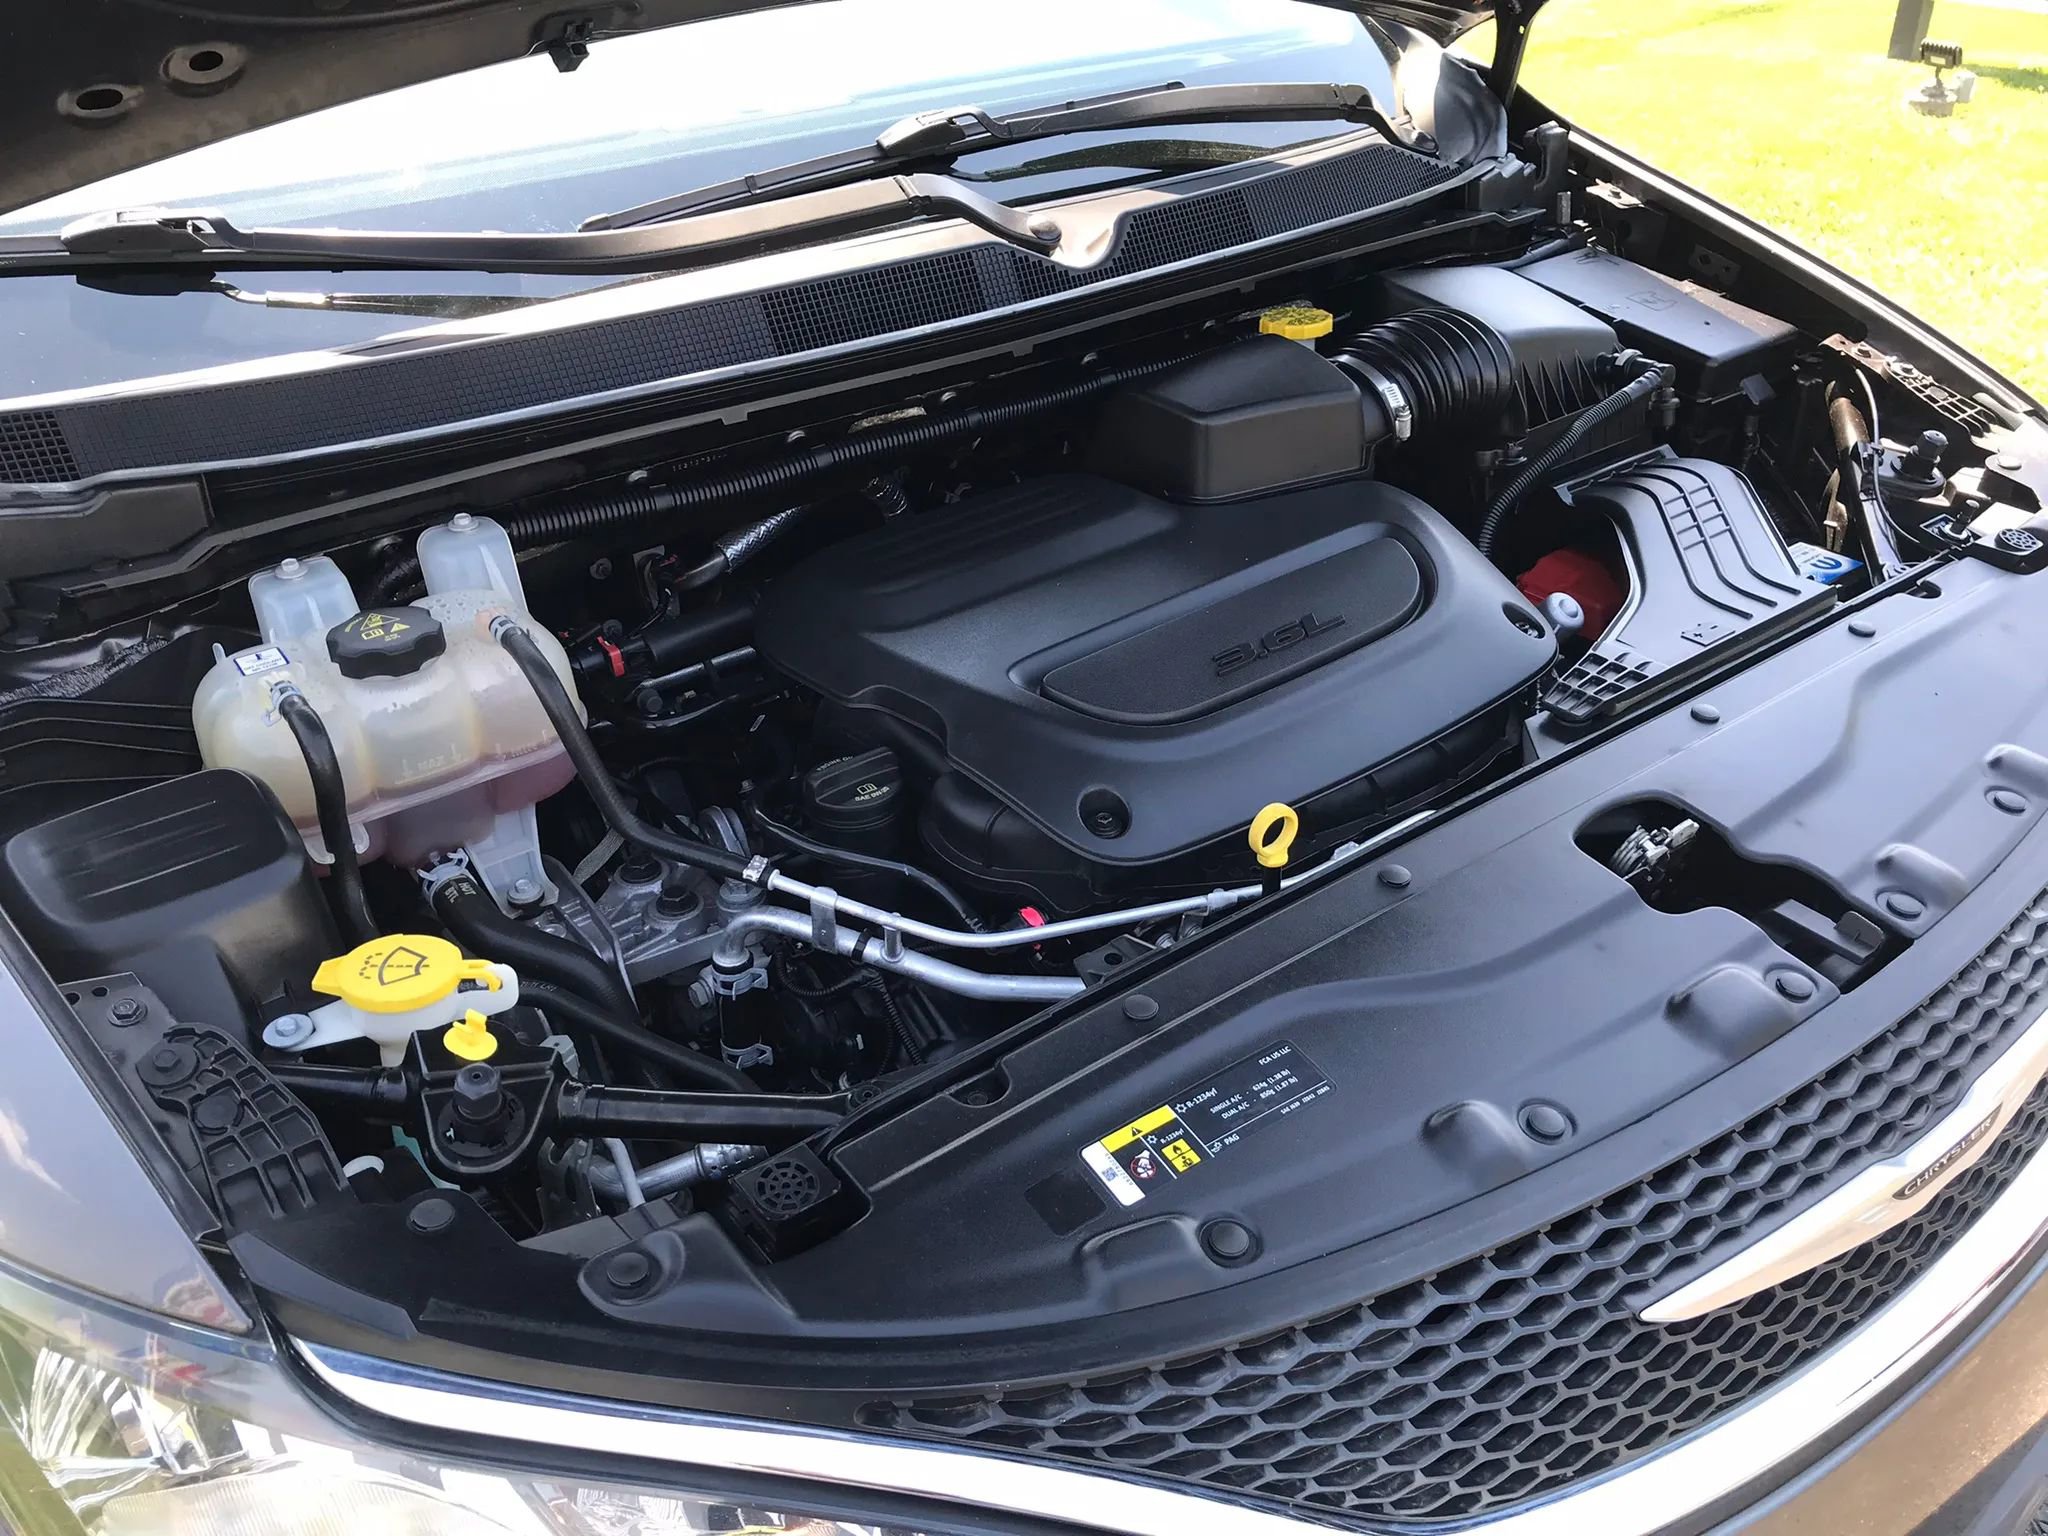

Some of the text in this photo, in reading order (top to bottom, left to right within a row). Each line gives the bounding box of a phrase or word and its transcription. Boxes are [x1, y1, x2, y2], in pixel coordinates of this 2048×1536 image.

[1212, 612, 1346, 677] 3.6L
[458, 882, 477, 895] HOT
[1258, 1045, 1292, 1066] FCA US LLC
[1185, 1087, 1218, 1109] R-1234yf
[1209, 1099, 1232, 1114] SINGLE
[1231, 1093, 1243, 1105] A/C
[1221, 1107, 1239, 1120] DUAL
[1238, 1100, 1250, 1111] A/C
[1223, 1133, 1240, 1146] PAG
[1904, 1118, 1992, 1195] CHRYSLER
